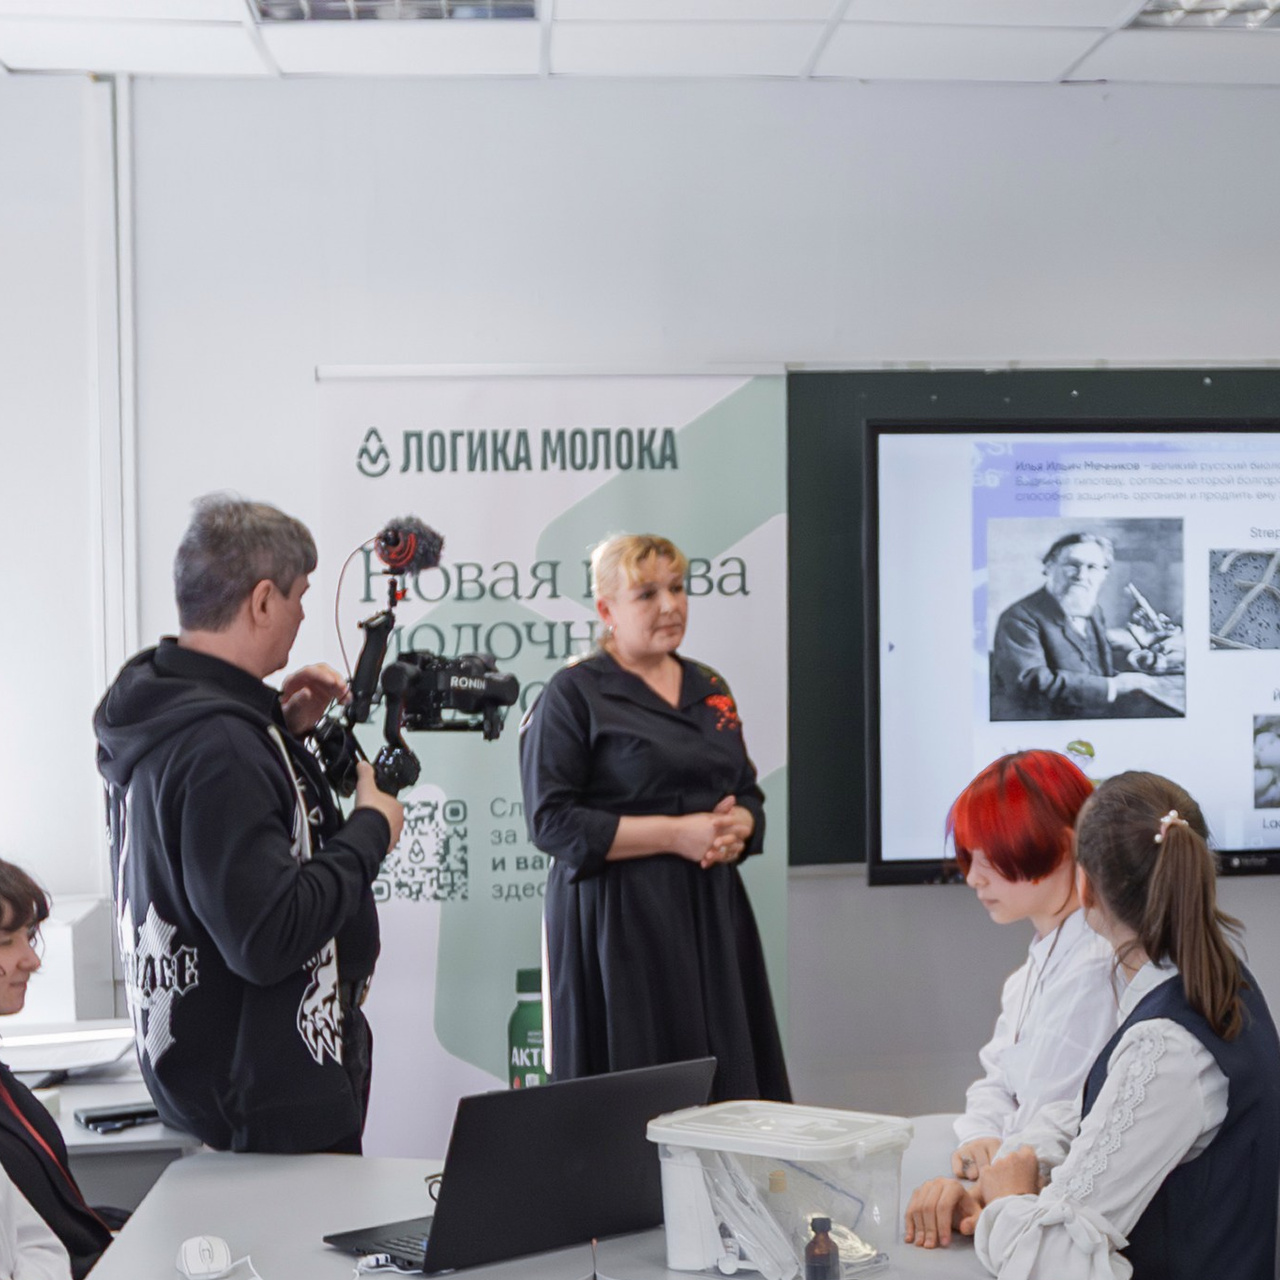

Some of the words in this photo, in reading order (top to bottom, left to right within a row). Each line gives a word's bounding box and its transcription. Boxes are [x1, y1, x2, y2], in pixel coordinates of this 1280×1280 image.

[400, 429, 533, 473] ЛОГИКА
[540, 427, 680, 471] МОЛОКА
[450, 675, 486, 690] RONIN
[490, 829, 517, 845] за
[491, 857, 506, 872] и
[491, 882, 547, 902] здес
[511, 1046, 546, 1067] АКТ
